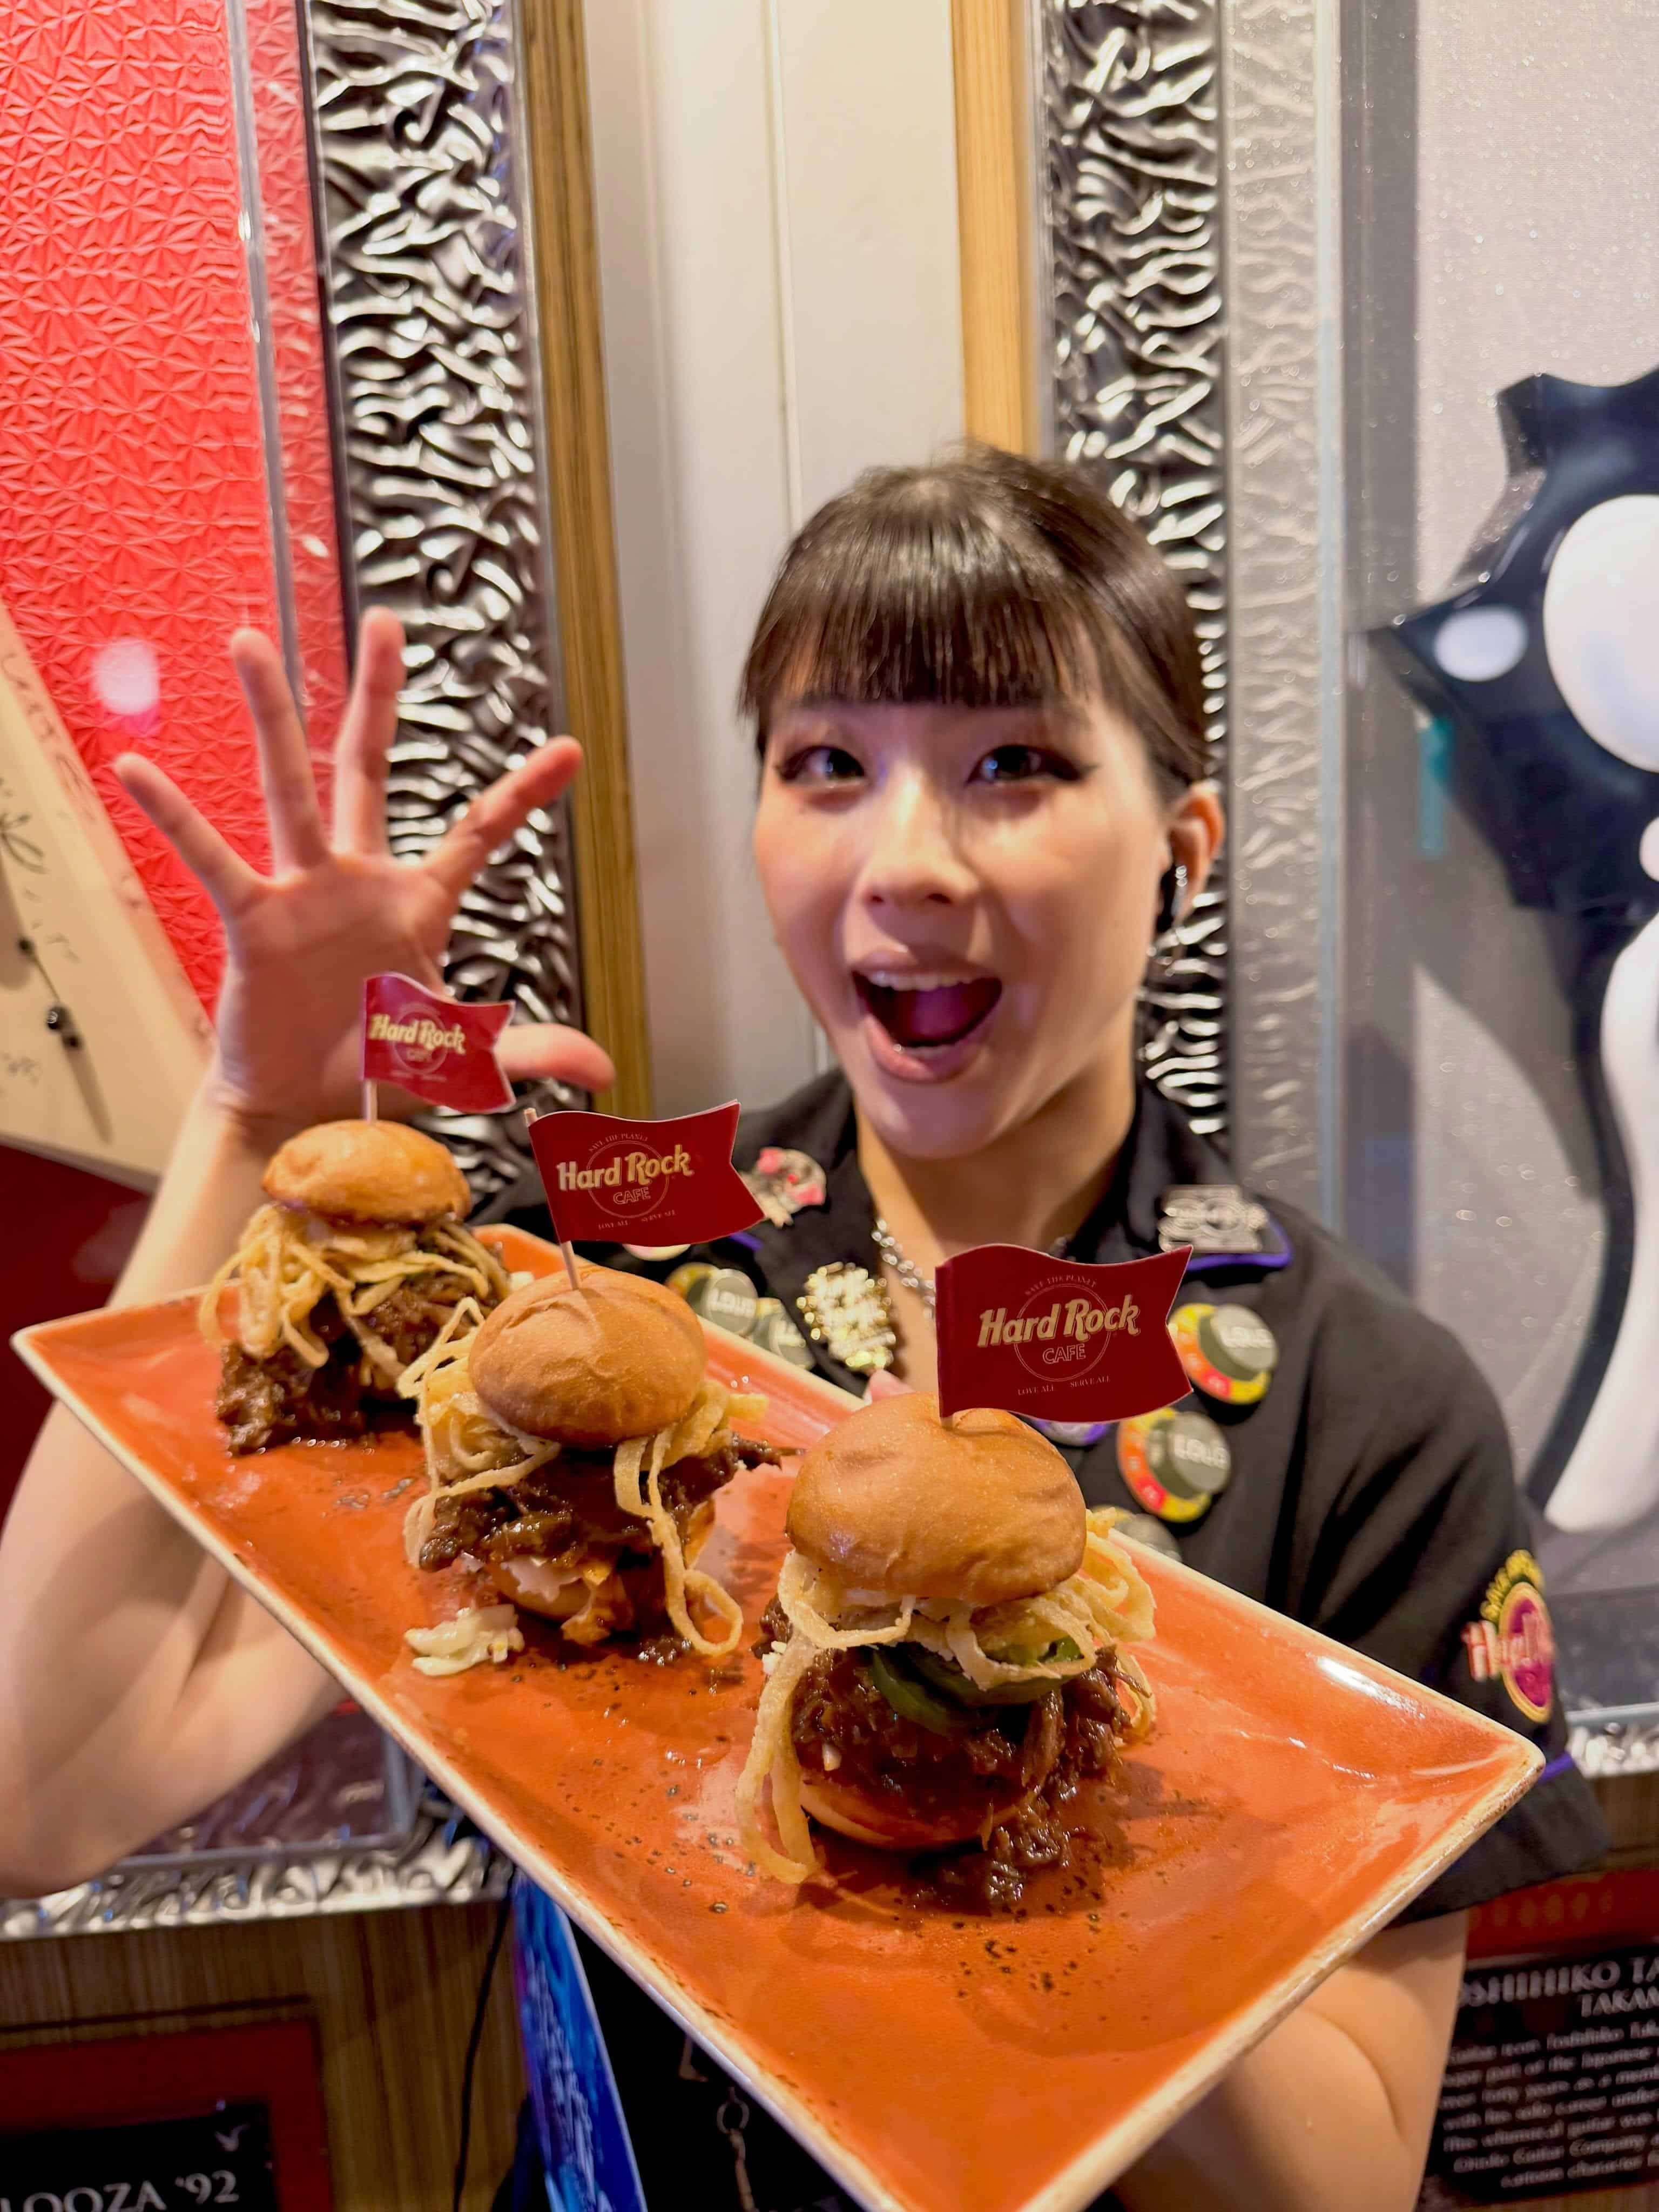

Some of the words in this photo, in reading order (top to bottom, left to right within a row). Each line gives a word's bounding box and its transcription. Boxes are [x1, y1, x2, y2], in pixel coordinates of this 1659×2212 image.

[368, 1013, 419, 1044] Hard
[418, 1020, 466, 1055] Rock
[556, 1157, 622, 1191] Hard
[624, 1144, 695, 1185] Rock
[612, 1187, 651, 1205] CAFE
[976, 1303, 1062, 1347] Hard
[1063, 1294, 1141, 1343] Rock
[1042, 1343, 1087, 1364] CAFE
[1017, 1387, 1039, 1396] LOVE
[1070, 1378, 1095, 1388] SERVE
